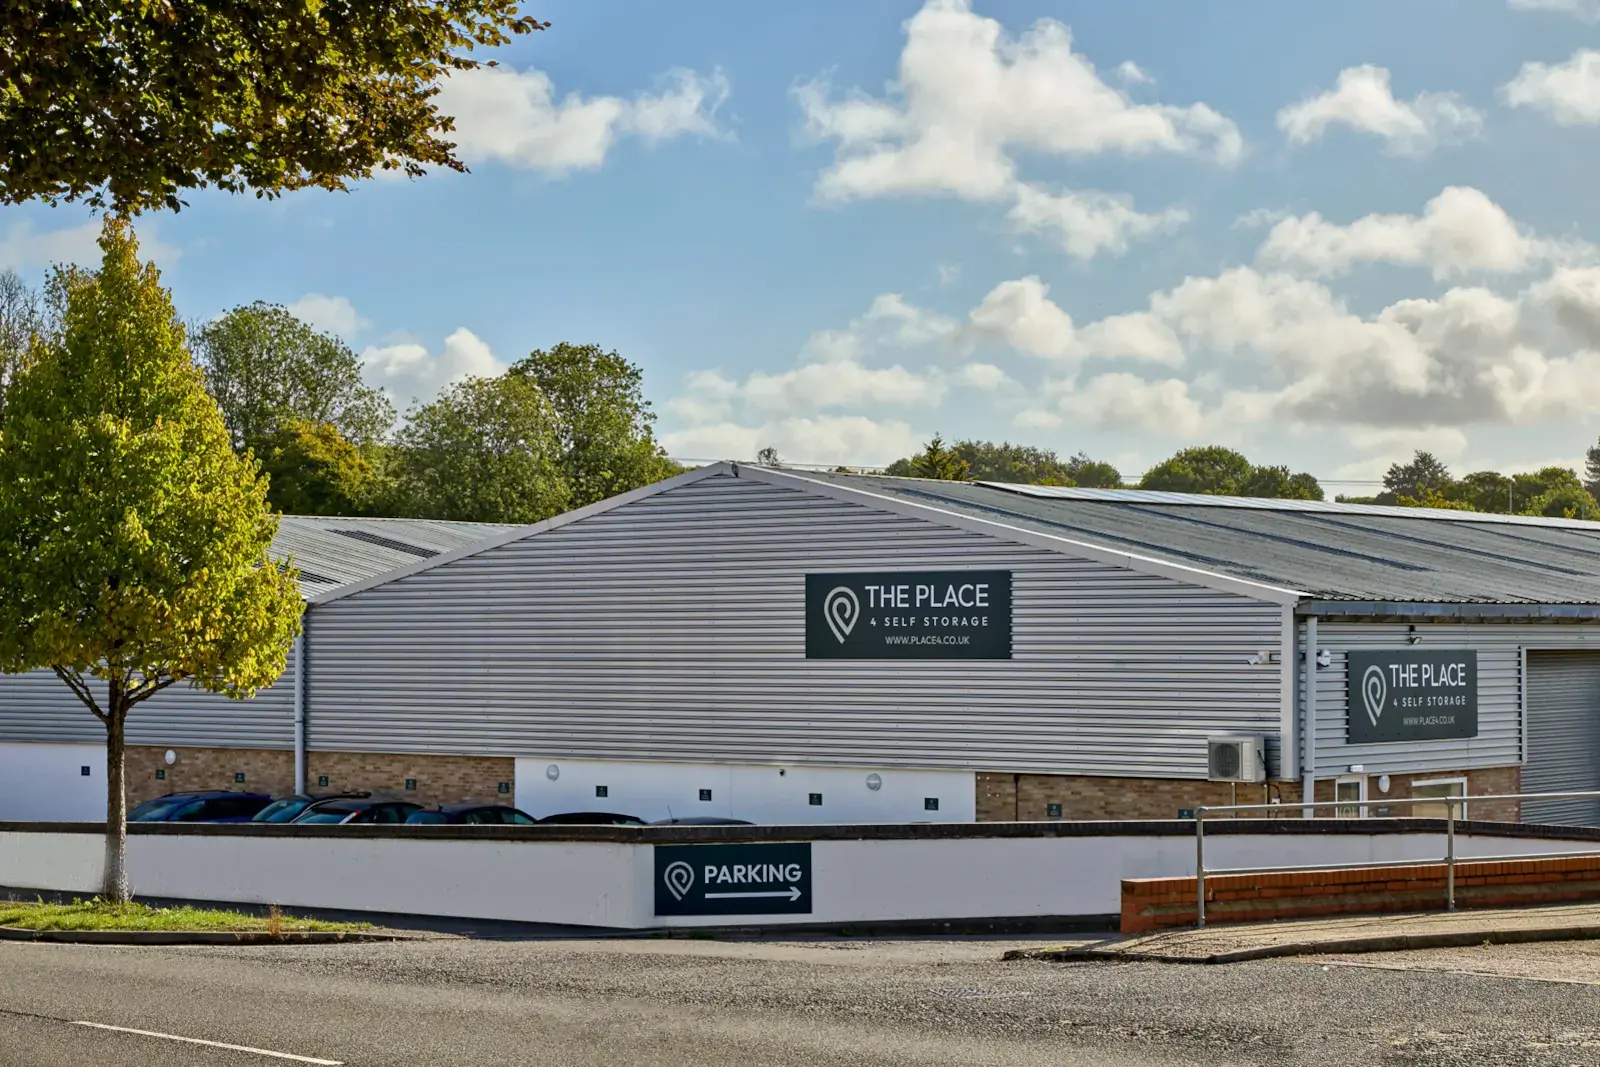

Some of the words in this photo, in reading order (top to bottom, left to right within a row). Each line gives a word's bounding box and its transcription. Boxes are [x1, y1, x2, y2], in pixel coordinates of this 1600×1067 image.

[865, 585, 909, 608] THE
[916, 584, 989, 608] PLACE
[870, 617, 877, 627] 4
[884, 616, 916, 627] SELF
[924, 616, 989, 627] STORAGE
[885, 636, 970, 645] WWW.PLACE4.CO.UK
[1389, 664, 1419, 688] THE
[1422, 663, 1466, 687] PLACE
[1393, 698, 1398, 707] 4
[1402, 697, 1423, 707] SELF
[1427, 695, 1466, 707] STORAGE
[1403, 716, 1456, 726] WWW.PLACE4.CO.UK
[704, 863, 802, 884] PARKING
